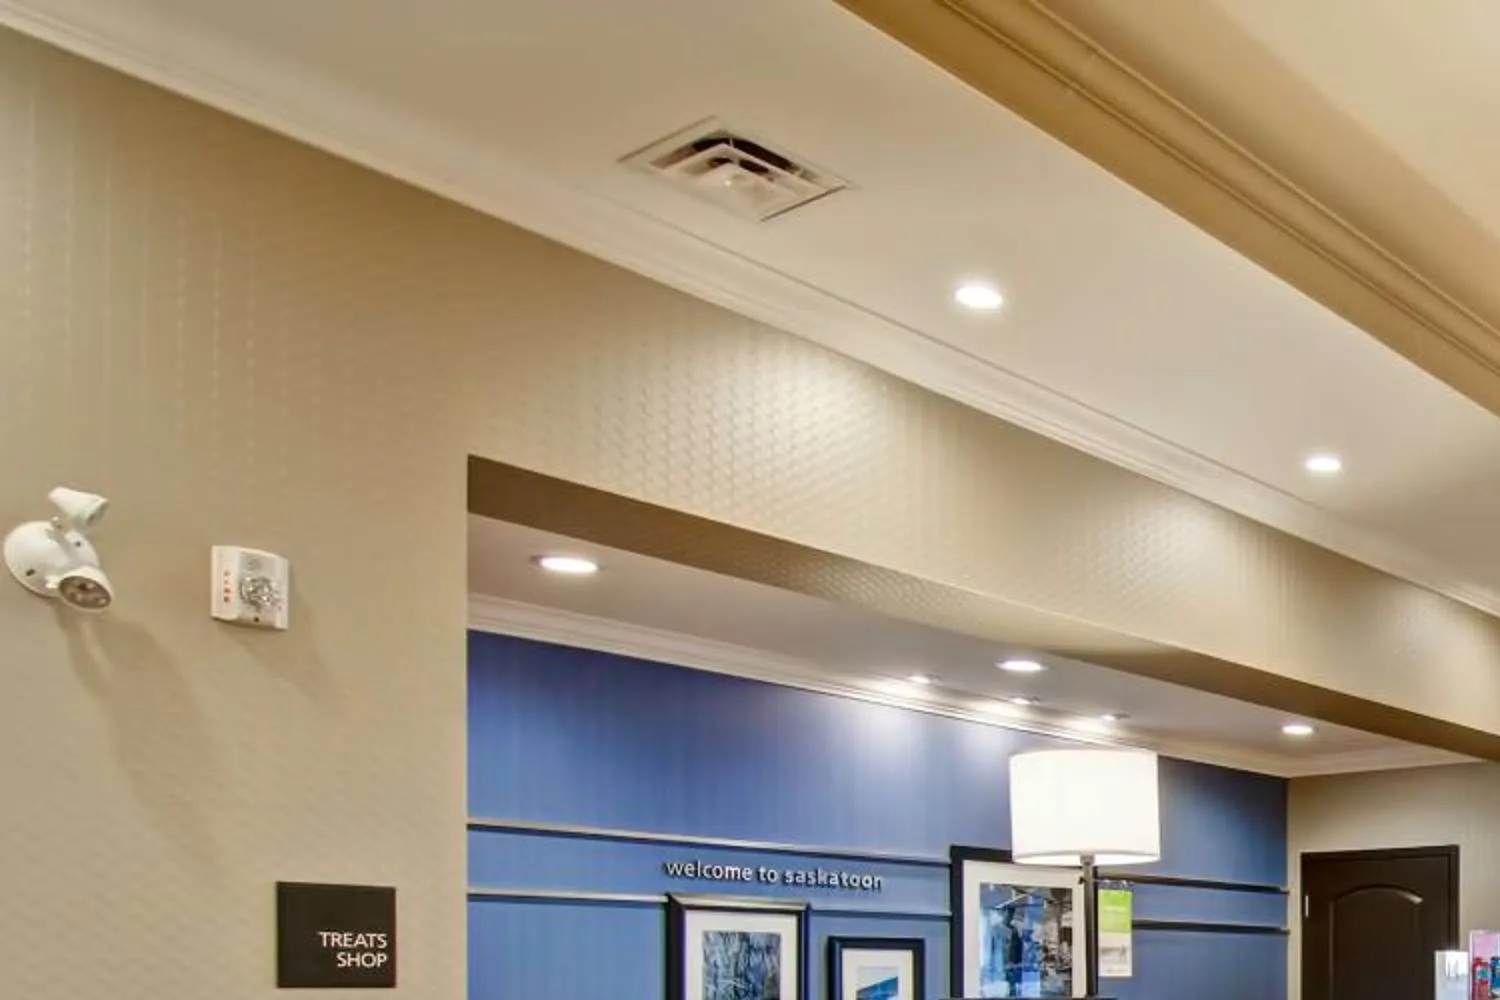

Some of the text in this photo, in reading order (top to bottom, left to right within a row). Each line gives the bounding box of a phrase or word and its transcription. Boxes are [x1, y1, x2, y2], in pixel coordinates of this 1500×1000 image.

[666, 860, 883, 890] welcome to saskatoon
[318, 931, 388, 949] TREATS
[336, 951, 388, 969] SHOP
